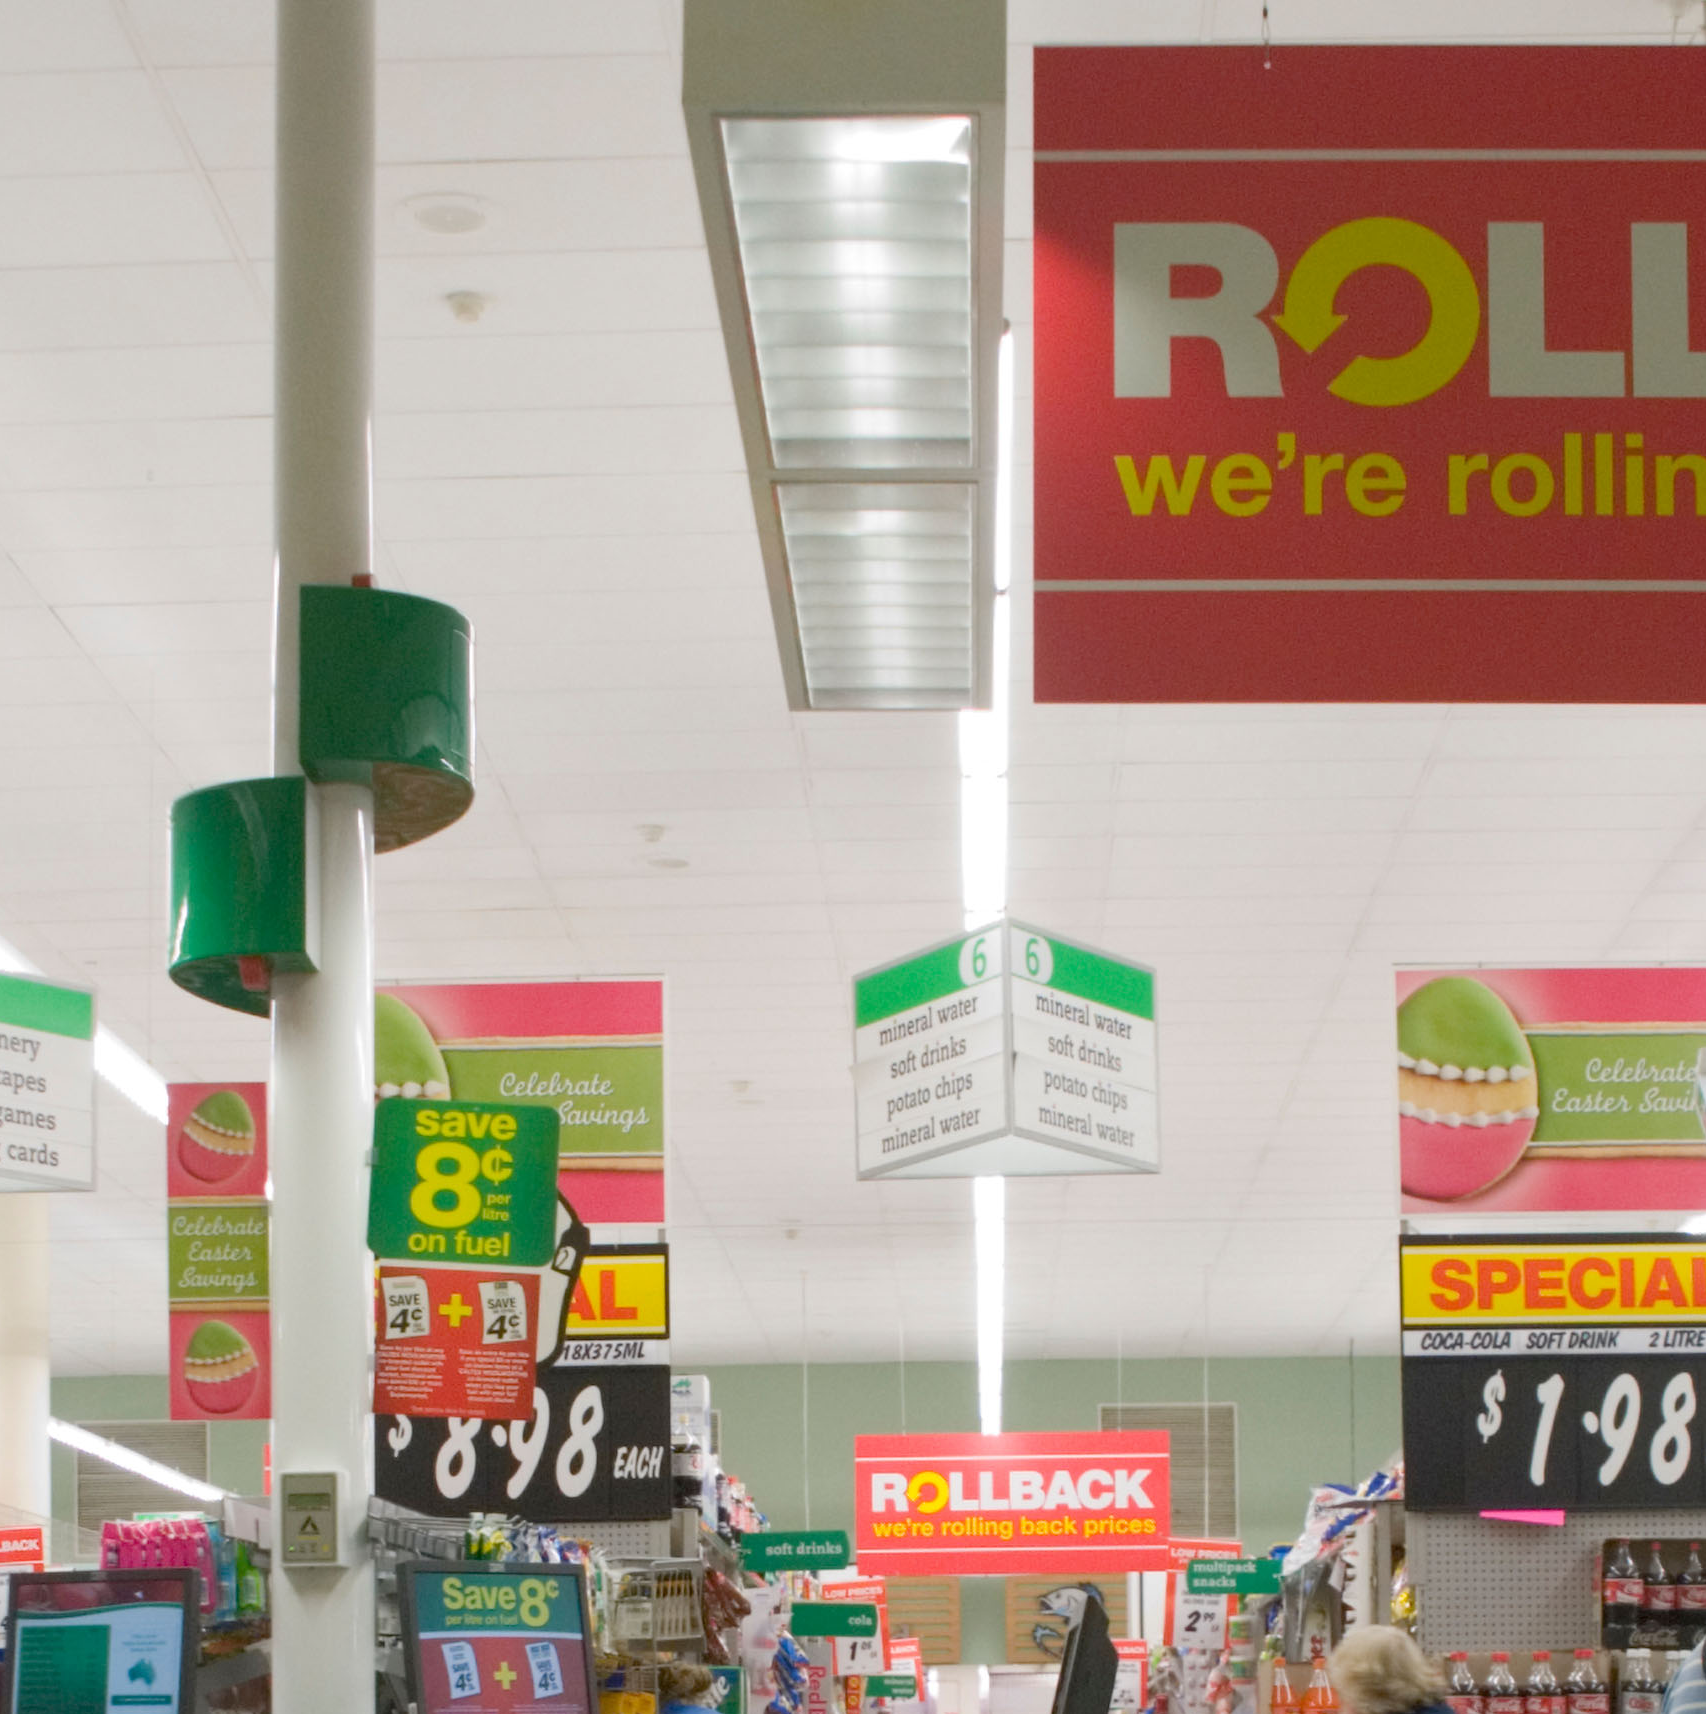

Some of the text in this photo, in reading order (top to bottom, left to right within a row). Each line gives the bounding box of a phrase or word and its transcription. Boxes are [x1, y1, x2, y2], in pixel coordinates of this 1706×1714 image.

[1113, 431, 1406, 518] we're
[972, 938, 986, 979] 6
[1025, 938, 1040, 976] 6
[879, 995, 978, 1047] mineral water
[1036, 992, 1132, 1040] mineral water
[890, 1036, 966, 1079] soft drinks
[1048, 1034, 1122, 1073] soft drinks
[500, 1072, 613, 1096] Celebrate
[1585, 1058, 1697, 1083] Celebrate
[887, 1072, 973, 1122] potato chips
[1044, 1069, 1128, 1113] potato chips
[1552, 1088, 1631, 1113] Easter
[415, 1109, 517, 1141] save
[558, 1101, 649, 1132] Savings
[1039, 1104, 1135, 1149] mineral water
[881, 1107, 981, 1154] mineral water
[7, 1144, 59, 1166] cards
[486, 1193, 511, 1206] per
[173, 1216, 265, 1236] Celebrate
[482, 1208, 509, 1221] litre
[189, 1241, 253, 1262] Easter
[408, 1230, 510, 1256] on fuel
[178, 1266, 259, 1294] Savings
[389, 1294, 420, 1307] SAVE
[488, 1298, 516, 1309] SAVE
[563, 1341, 645, 1361] 18X375ML
[1421, 1330, 1706, 1350] COCA-COLA SOFT DRINK 2 LITRE
[613, 1446, 664, 1479] EACH
[871, 1469, 1155, 1514] ROLLBACK
[873, 1515, 1156, 1540] we're rolling back prices
[766, 1542, 843, 1556] soft drinks
[1192, 1561, 1257, 1574] multipack
[443, 1577, 516, 1611] Save
[1192, 1576, 1237, 1588] snacks
[848, 1615, 872, 1626] cola
[808, 1666, 827, 1704] Red
